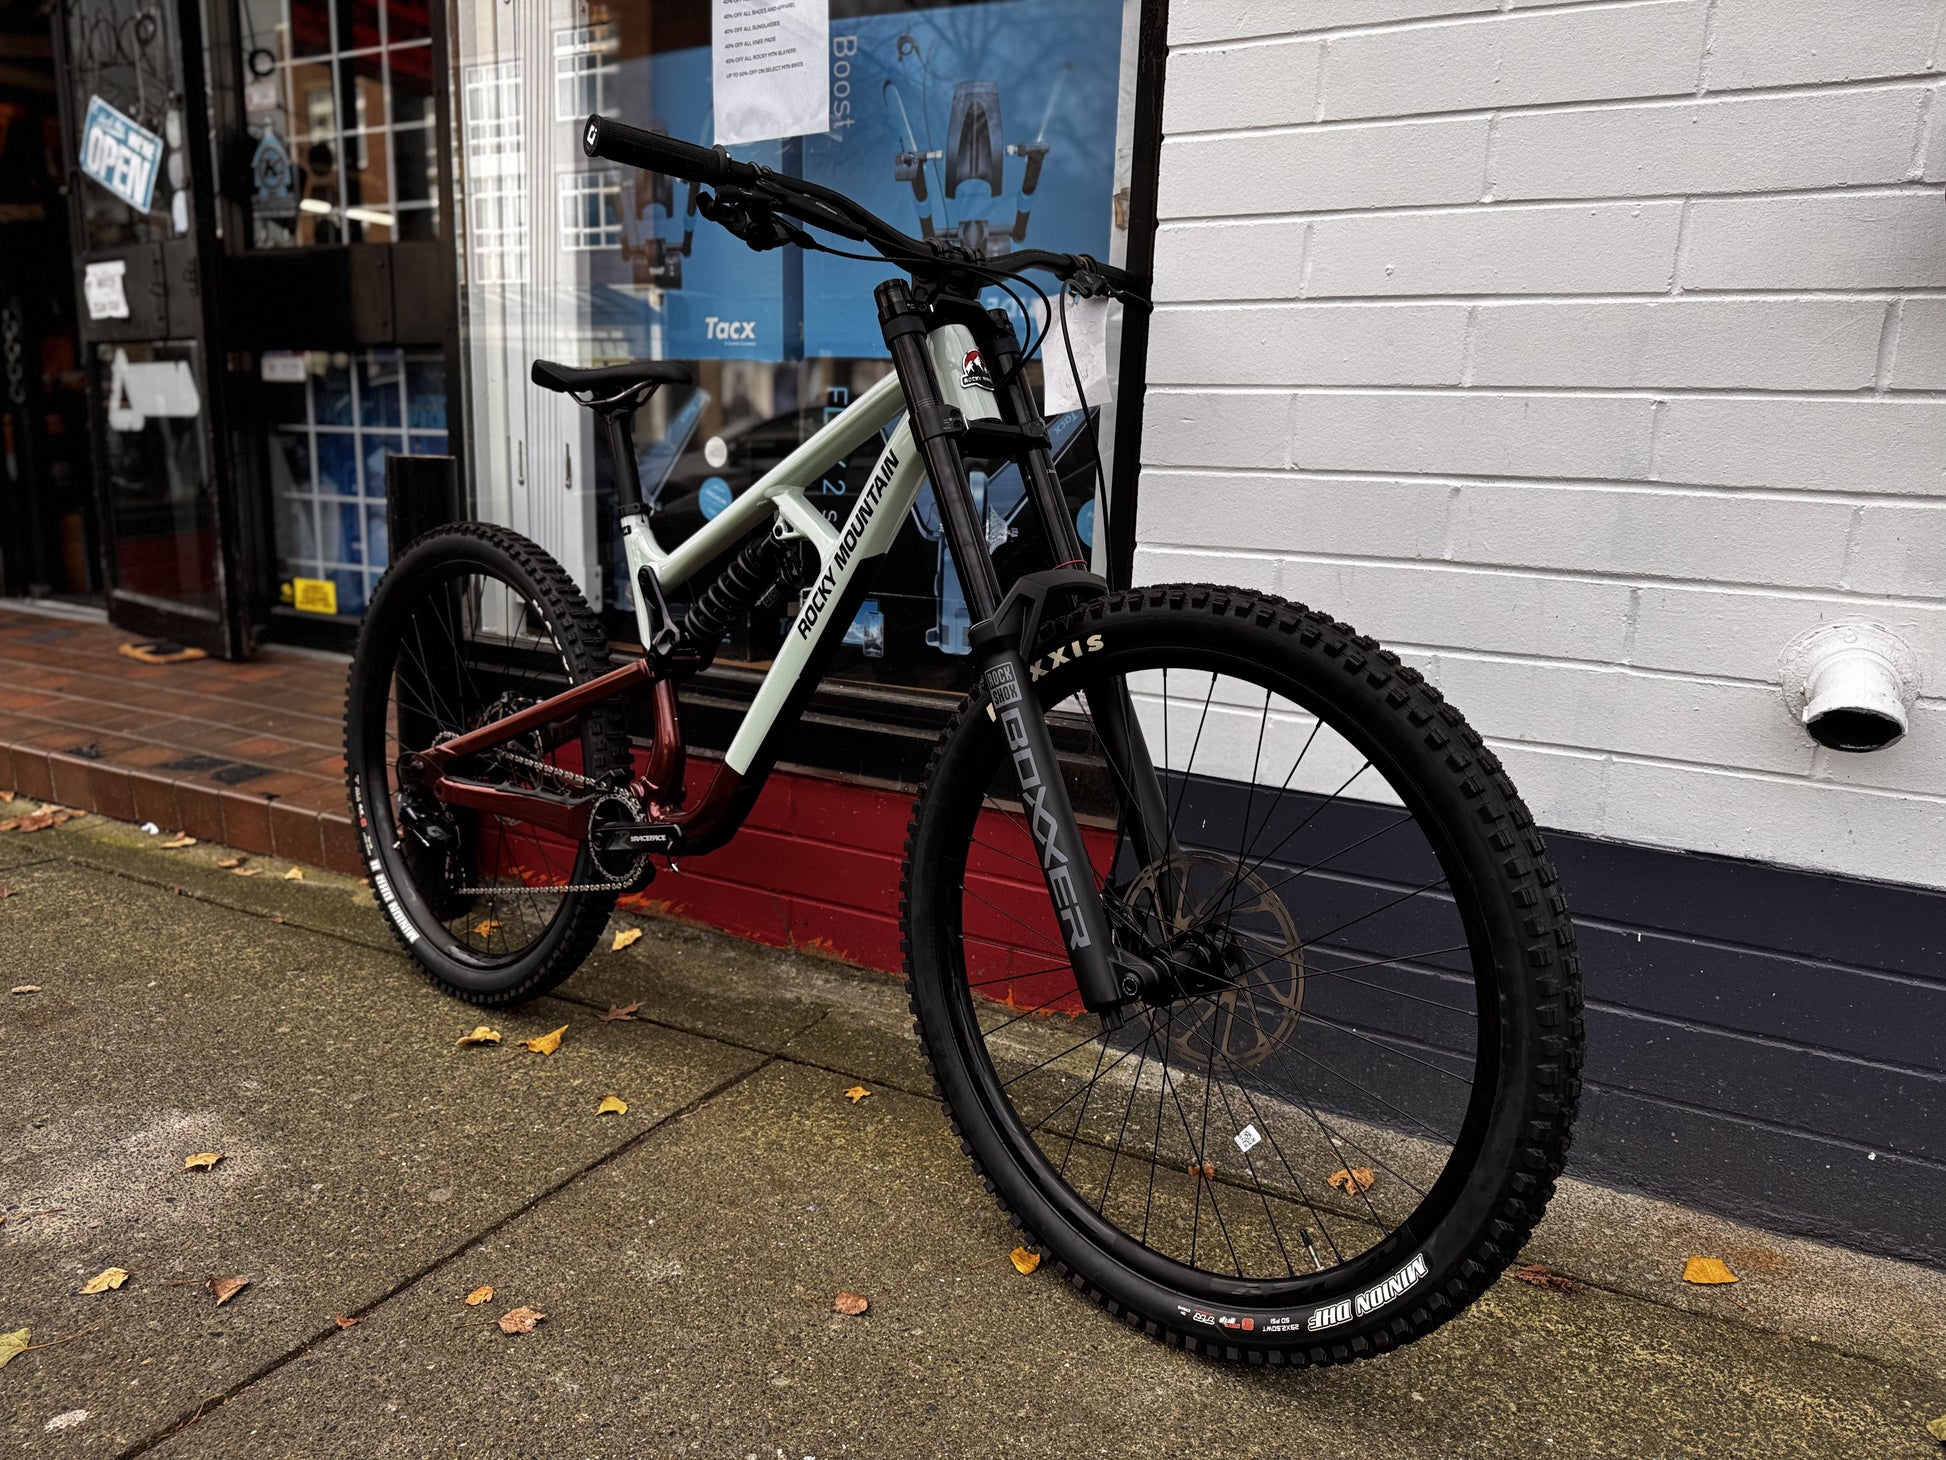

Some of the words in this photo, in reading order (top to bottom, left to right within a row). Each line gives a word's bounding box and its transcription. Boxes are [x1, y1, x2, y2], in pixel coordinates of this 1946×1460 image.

[777, 2, 796, 10] APPAREL
[752, 20, 780, 30] SUNGLASSES
[778, 47, 797, 56] SLAYERS
[765, 65, 781, 73] SELECT
[832, 36, 857, 128] Boost
[86, 125, 151, 205] OPEN
[705, 317, 756, 340] Tacx
[1053, 410, 1079, 435] Tacx
[822, 479, 846, 496] 2
[798, 565, 837, 640] ROCKY
[834, 448, 899, 571] MOUNTAIN
[1029, 634, 1104, 683] XXIS
[987, 665, 1013, 689] ROCK
[992, 683, 1018, 706] SHOX
[1001, 707, 1091, 950] BOXXER
[374, 873, 395, 904] DHR
[388, 900, 420, 944] MINION
[1355, 1252, 1429, 1317] MINION
[1307, 1299, 1353, 1332] DHF
